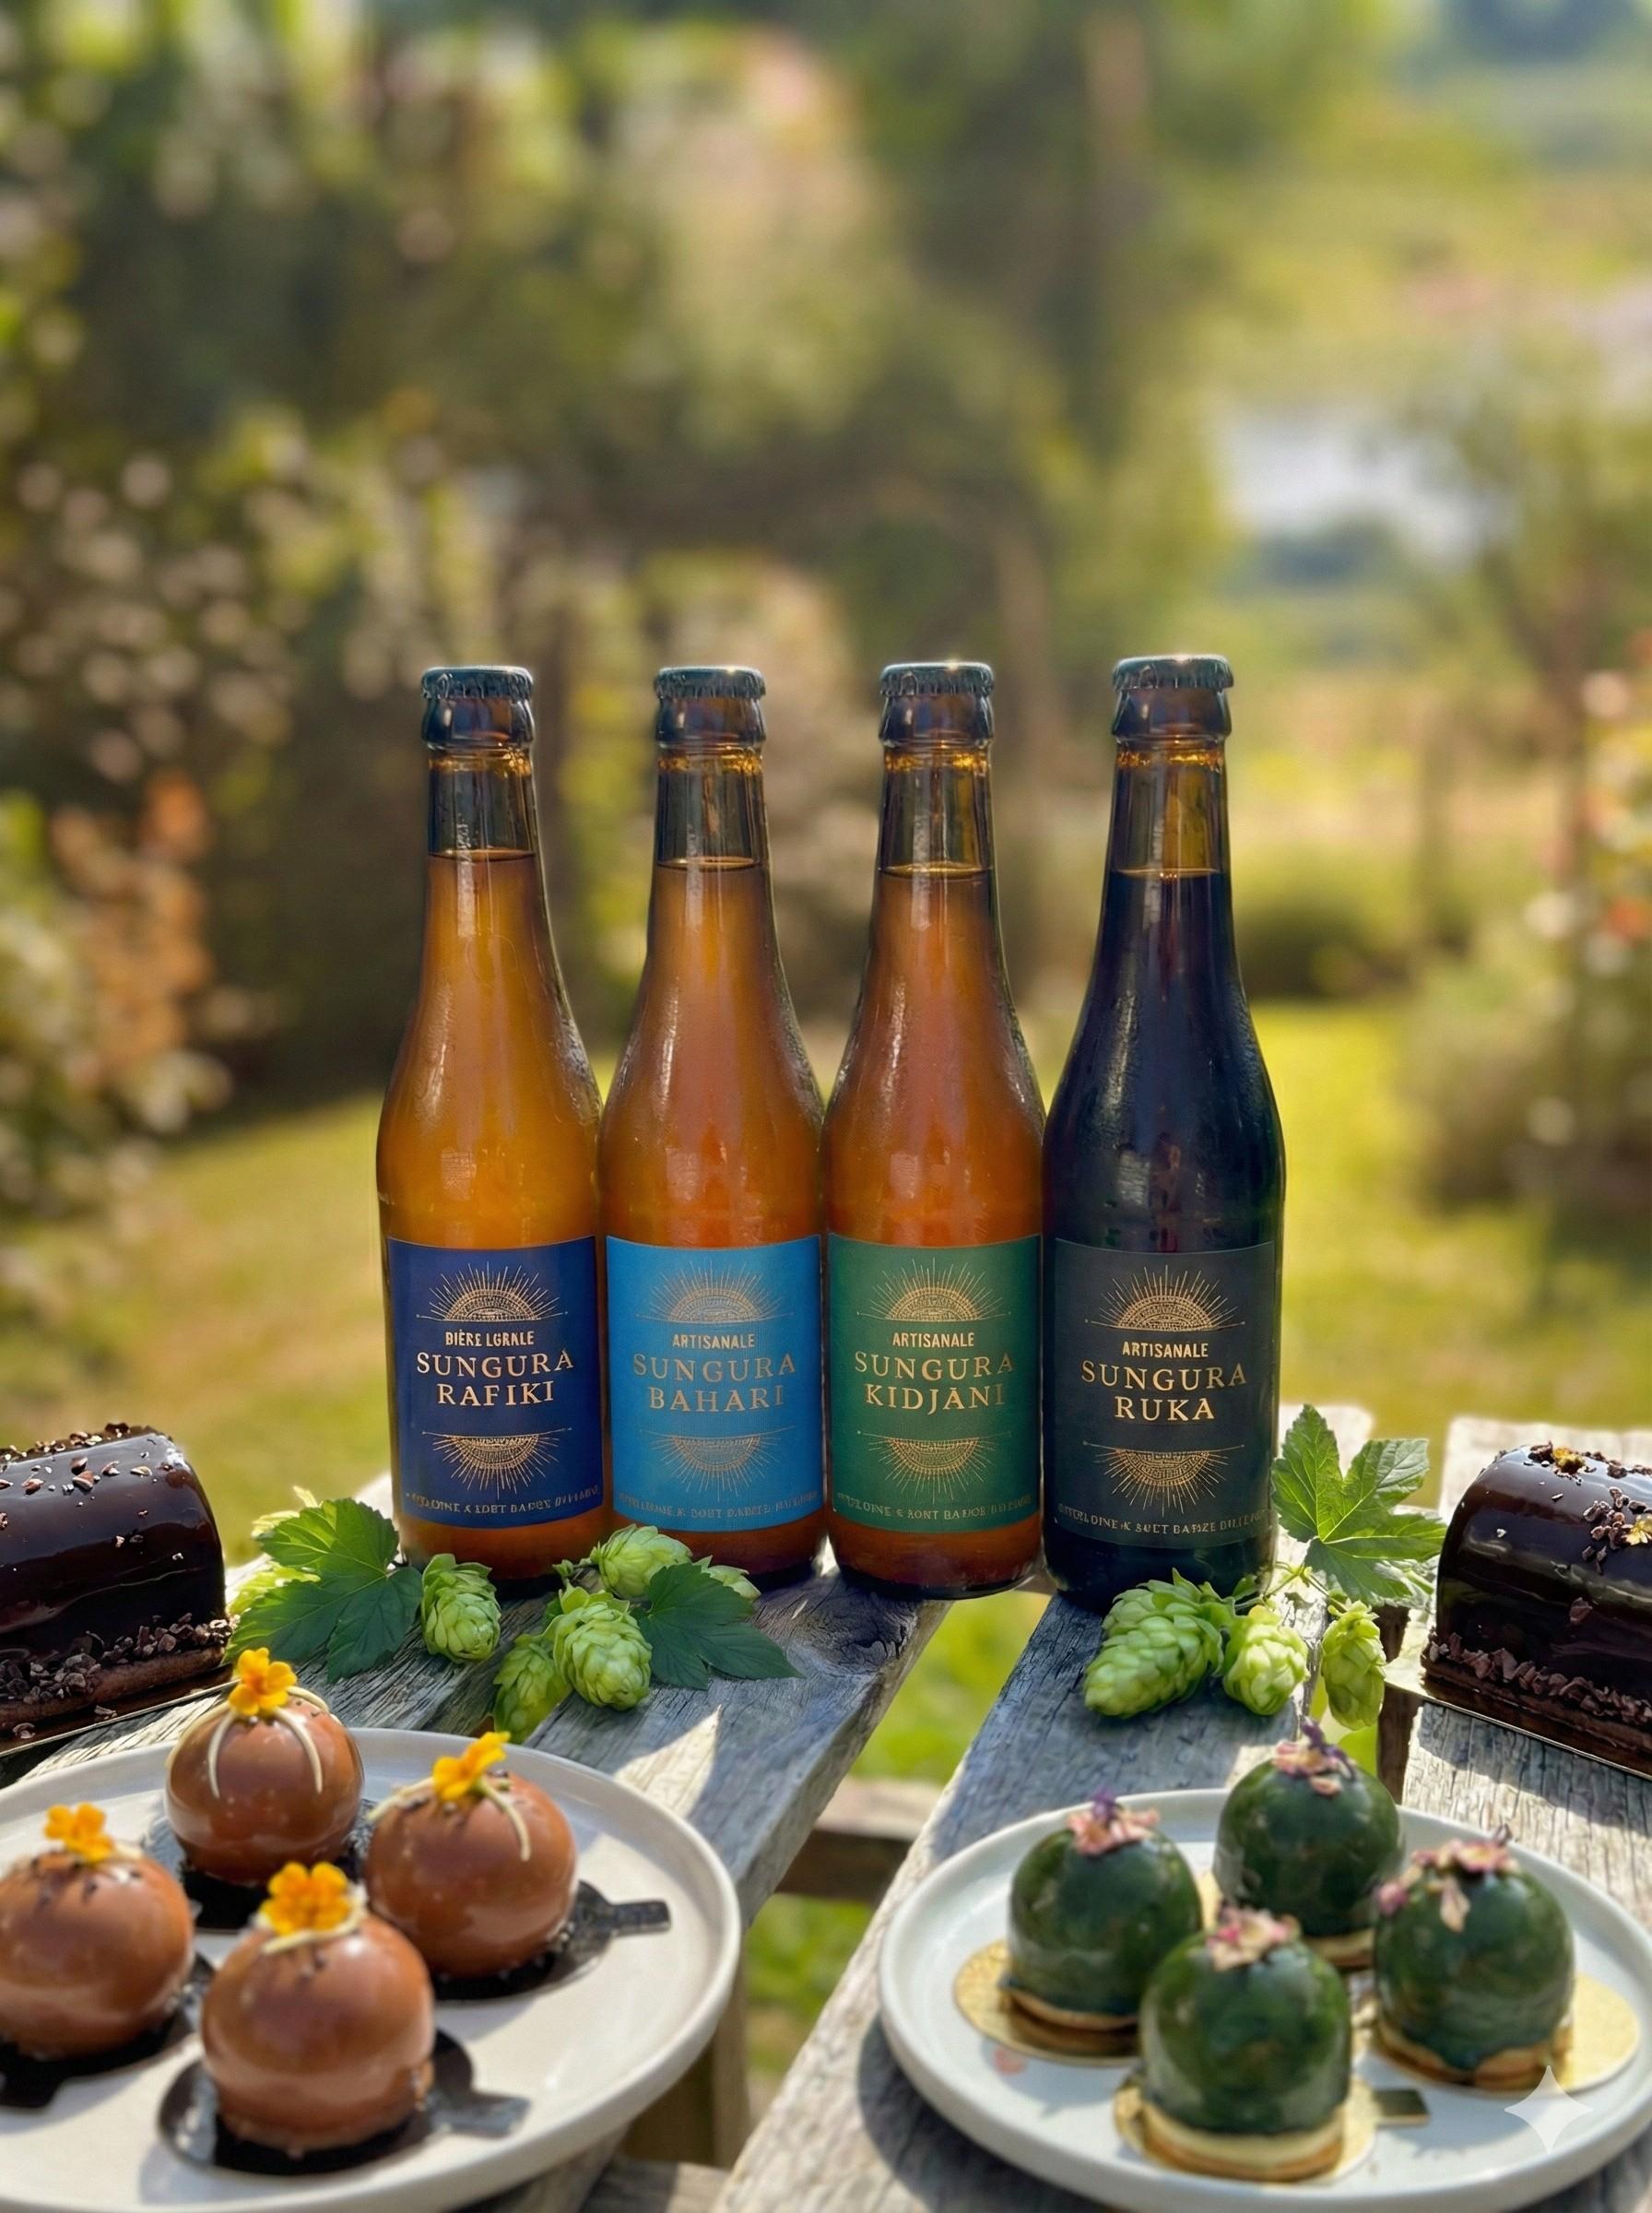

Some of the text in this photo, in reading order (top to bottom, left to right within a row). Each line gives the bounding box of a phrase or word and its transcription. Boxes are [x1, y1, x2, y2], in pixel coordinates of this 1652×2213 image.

[672, 1333, 756, 1350] ARTISANALE
[892, 1331, 974, 1348] ARTISANALE
[1122, 1342, 1209, 1358] ARTISANALE
[417, 1348, 574, 1379] SUNGURA
[633, 1354, 796, 1382] SUNGURA
[855, 1351, 1014, 1381] SUNGURA
[1080, 1360, 1247, 1391] SUNGURA
[436, 1380, 554, 1407] RAFIKI
[648, 1385, 785, 1413] BAHARI
[1114, 1396, 1215, 1421] RUKA
